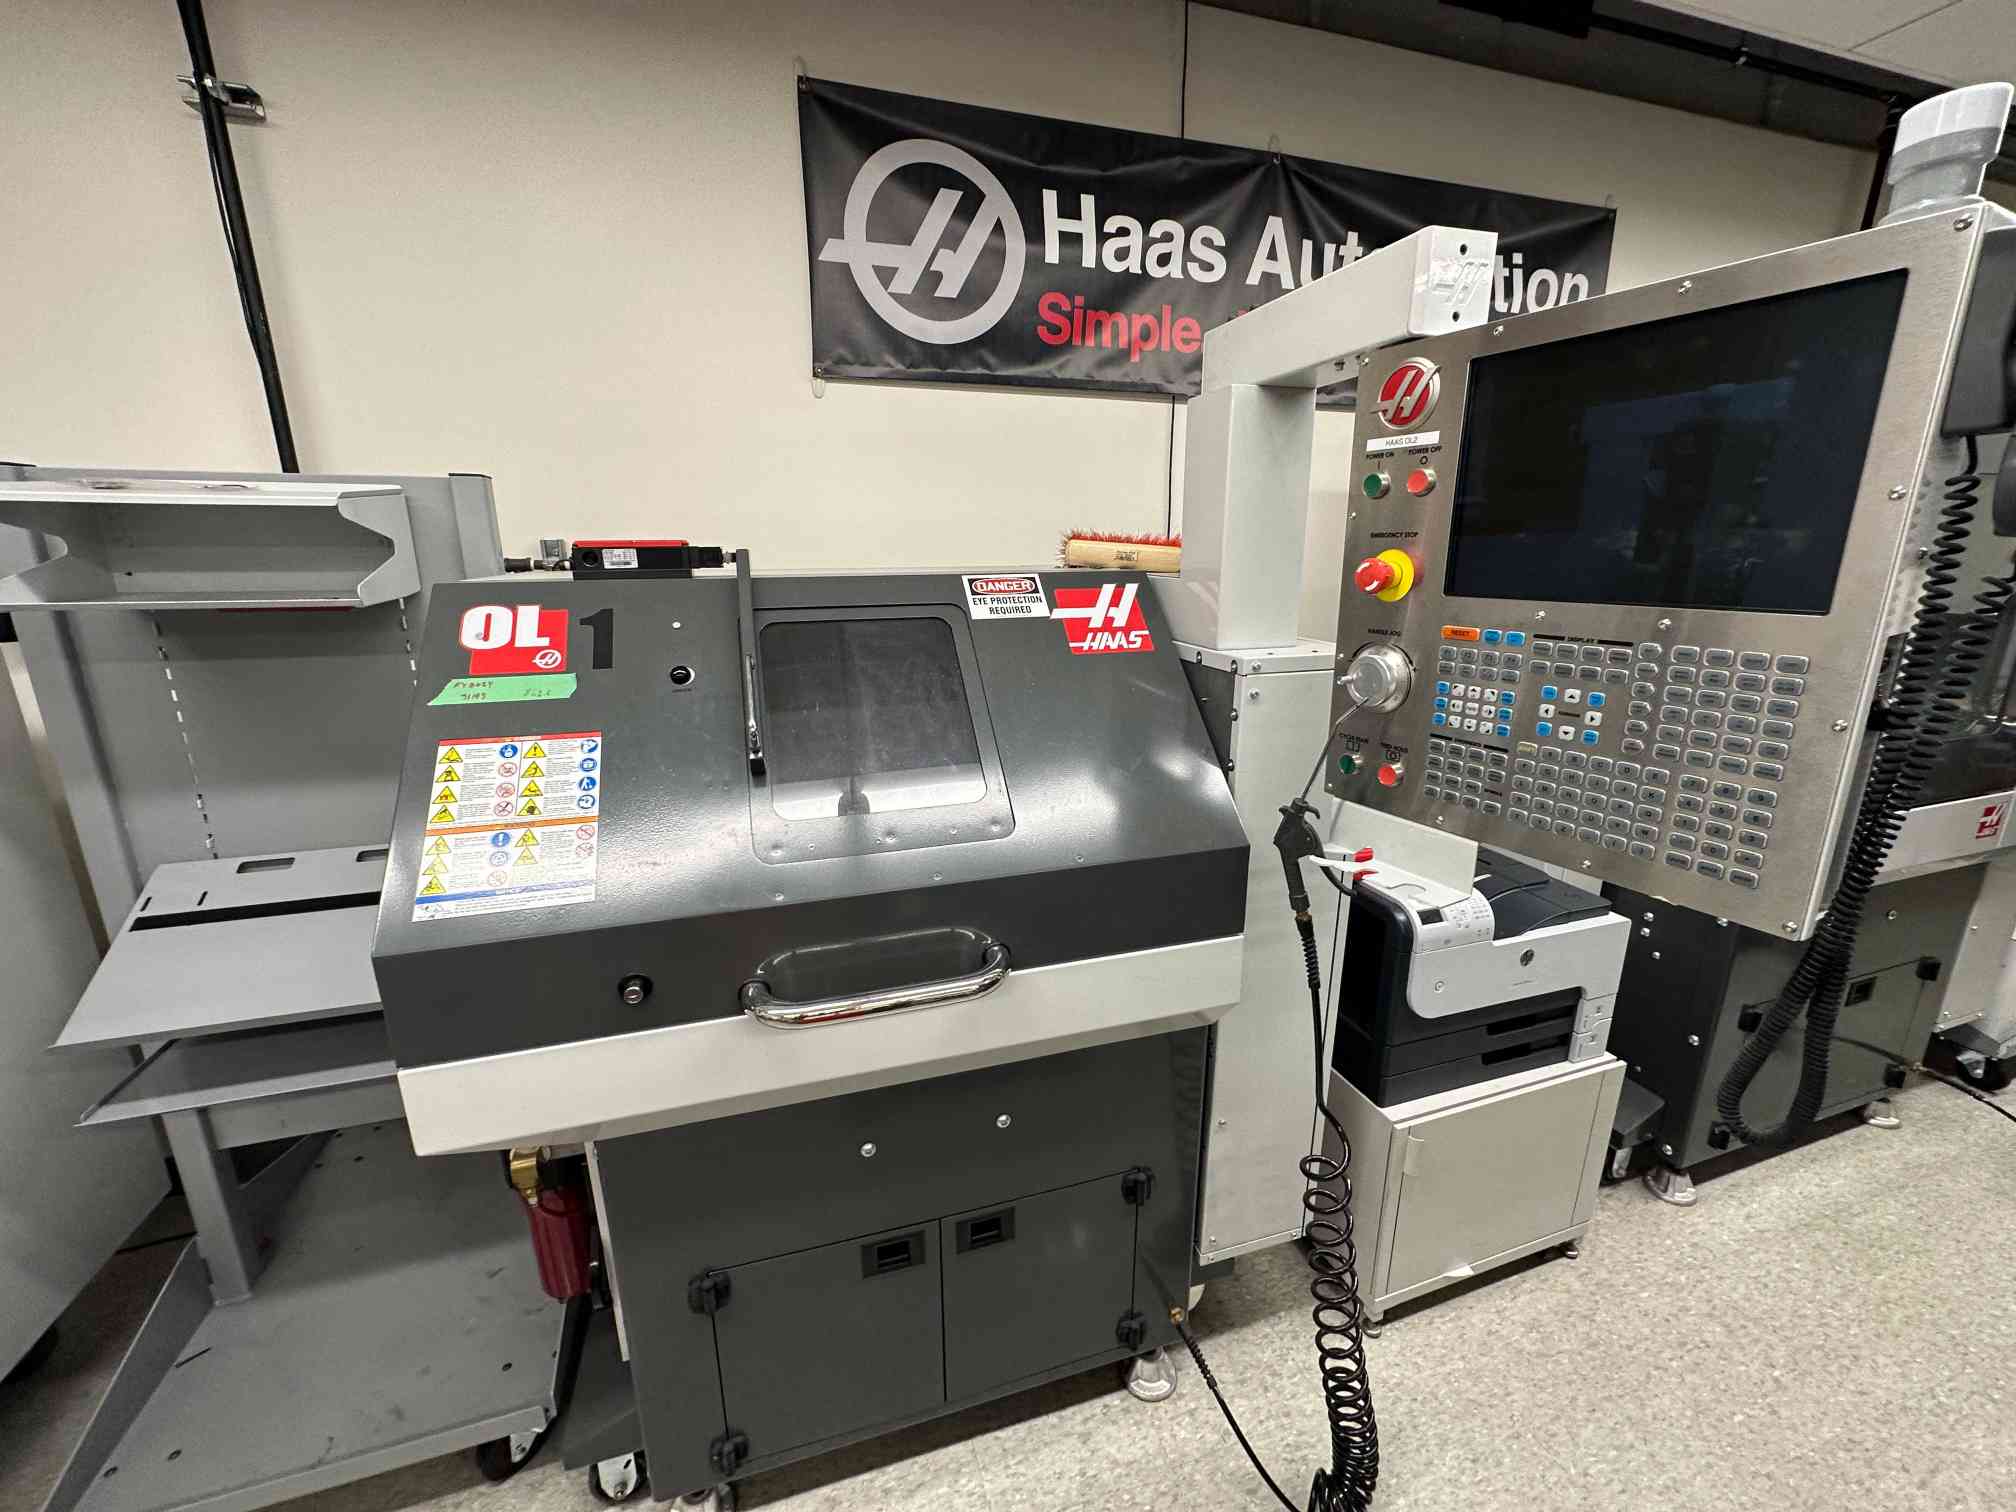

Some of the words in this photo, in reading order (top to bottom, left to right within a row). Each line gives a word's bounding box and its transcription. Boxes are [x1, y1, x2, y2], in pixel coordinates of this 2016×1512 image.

[1042, 188, 1227, 283] Haas
[1245, 215, 1590, 314] Auttion
[1036, 291, 1201, 363] Simple
[1408, 447, 1429, 455] POWER
[977, 579, 1032, 593] DANGER
[972, 596, 989, 606] EYE
[990, 595, 1043, 605] PROTECTION
[989, 605, 1032, 615] REQUIRED
[461, 605, 550, 649] OL
[579, 608, 613, 670] 1
[1069, 631, 1149, 650] HAAS
